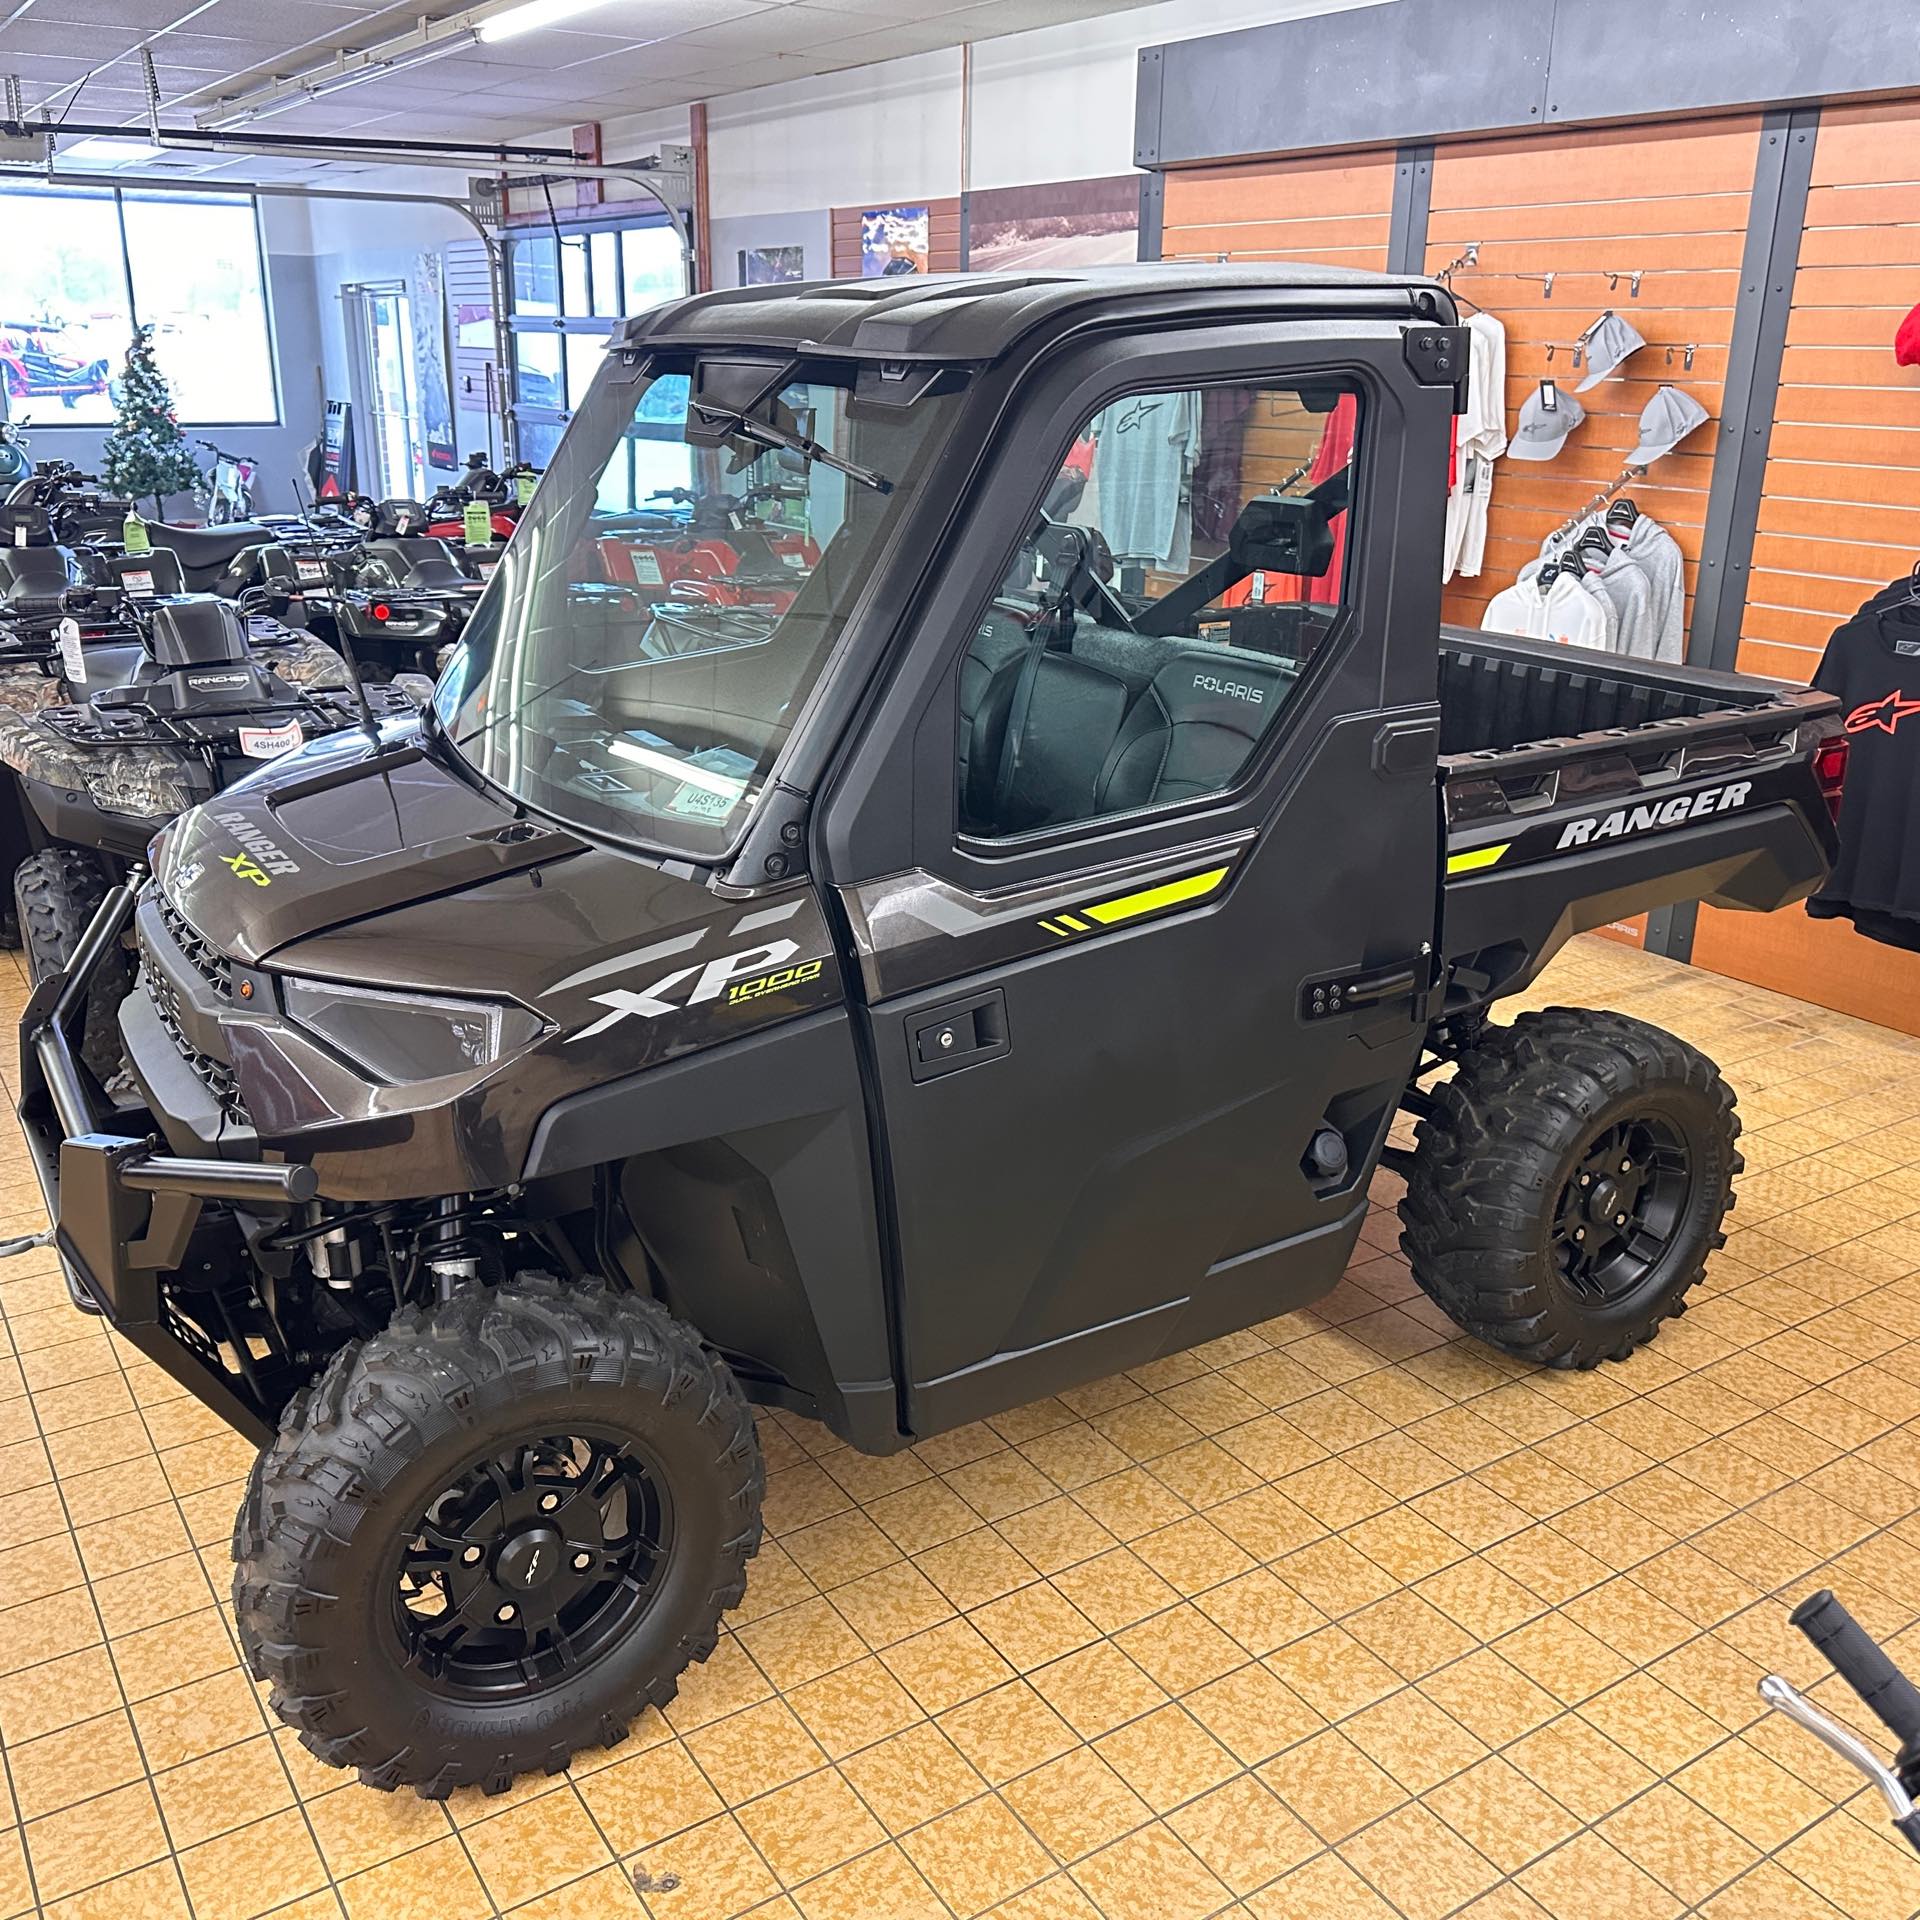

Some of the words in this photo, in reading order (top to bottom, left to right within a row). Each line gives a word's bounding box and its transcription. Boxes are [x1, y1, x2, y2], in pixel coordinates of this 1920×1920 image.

[188, 675, 250, 686] RANCHER
[1192, 674, 1264, 704] POLARIS
[253, 739, 290, 750] 4SH400
[687, 792, 727, 807] U4S135
[1555, 781, 1752, 850] RANGER
[213, 811, 300, 876] RANGER
[218, 852, 272, 887] XP
[562, 938, 801, 1044] XP
[728, 959, 822, 1000] 1000
[729, 995, 753, 1005] DUAL
[754, 980, 800, 997] OVERHEAD
[800, 973, 821, 985] CAM
[525, 1549, 540, 1585] XP
